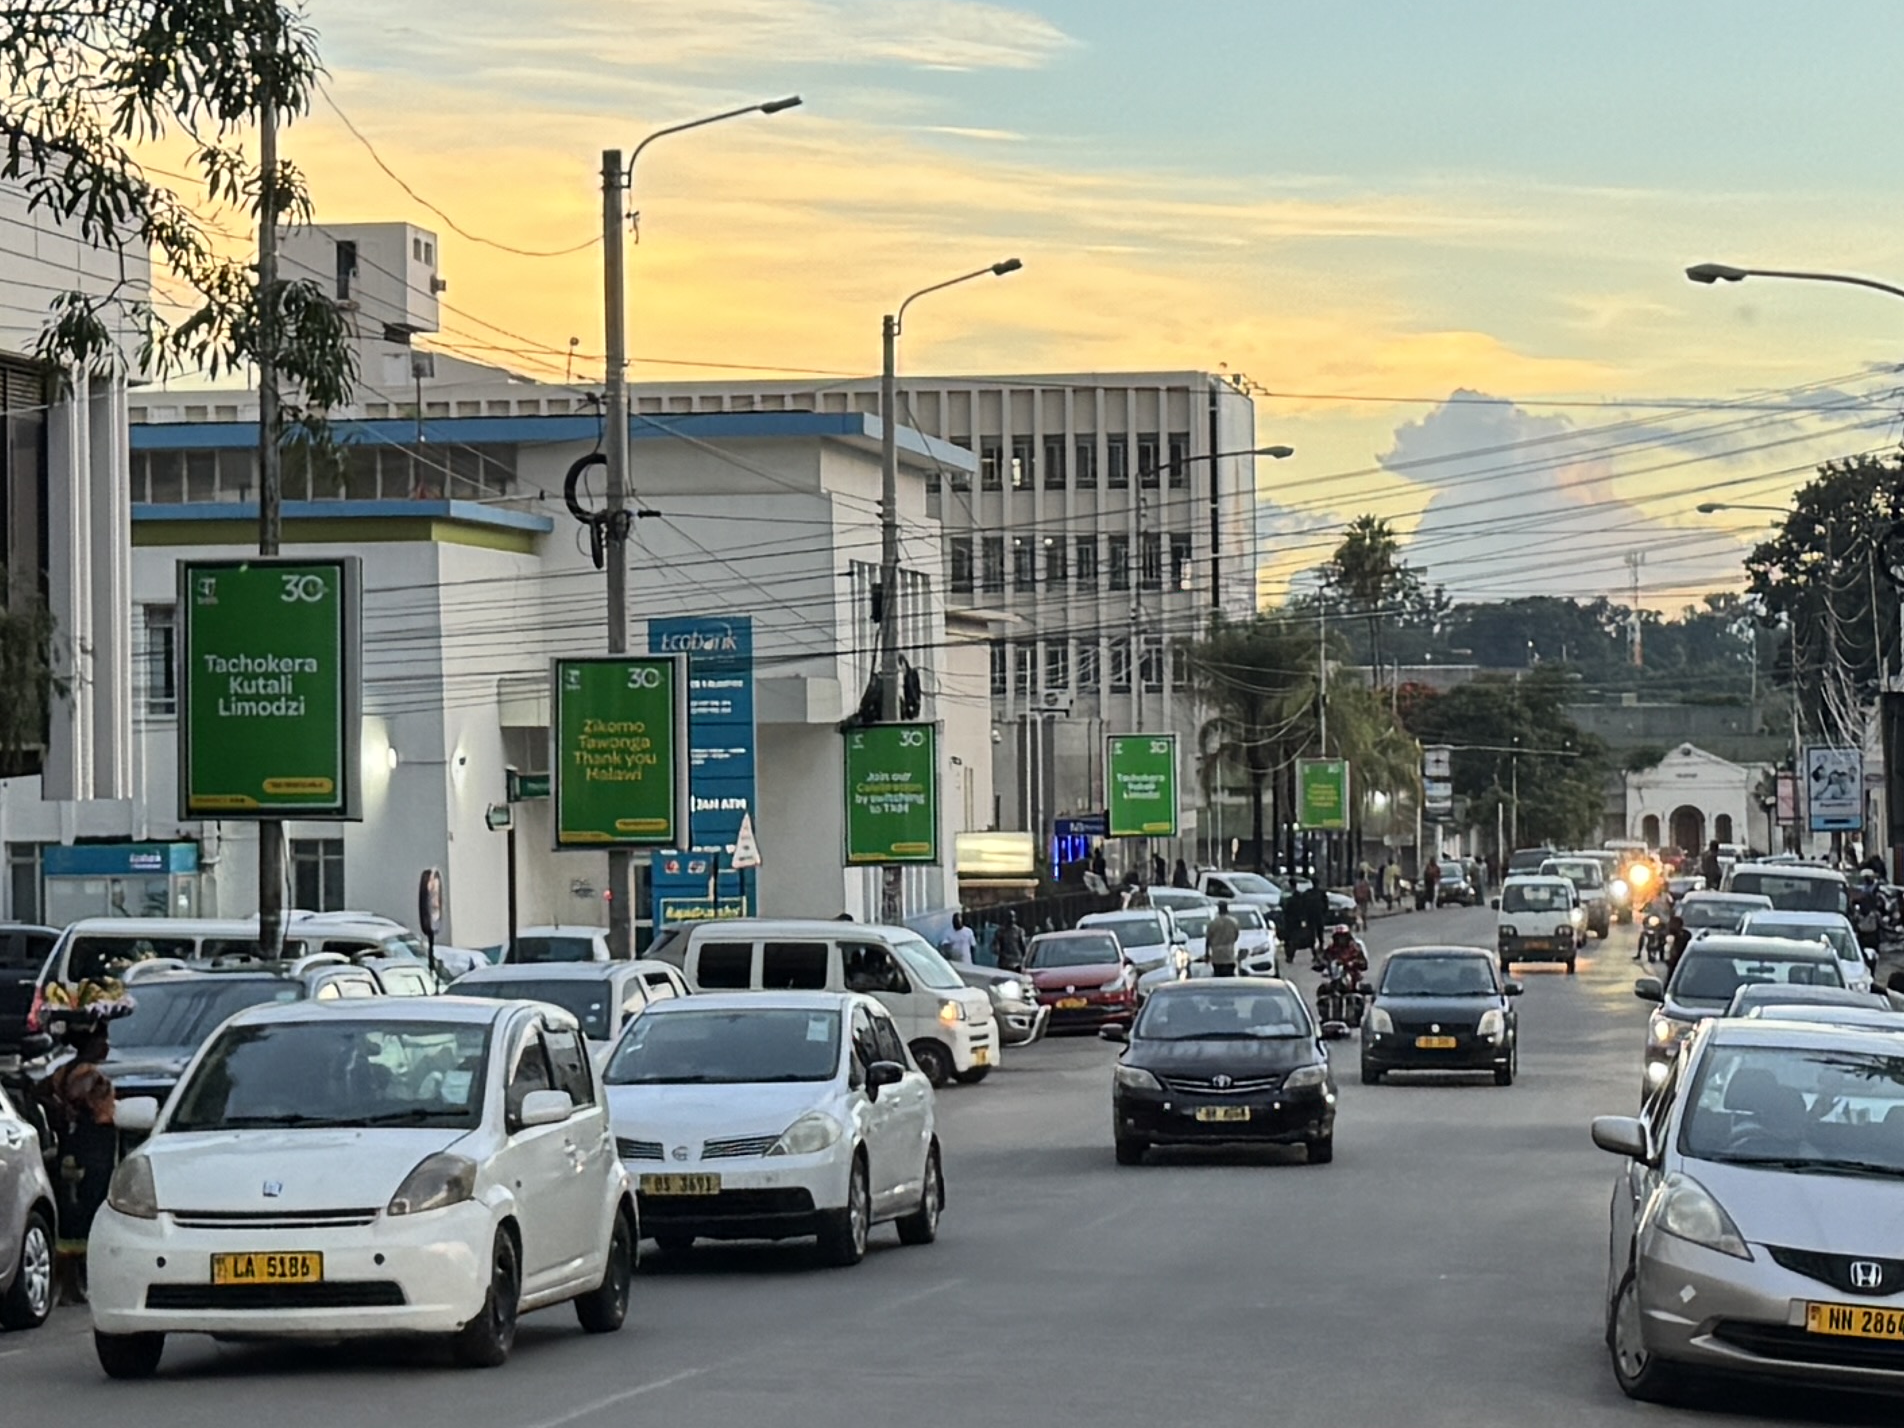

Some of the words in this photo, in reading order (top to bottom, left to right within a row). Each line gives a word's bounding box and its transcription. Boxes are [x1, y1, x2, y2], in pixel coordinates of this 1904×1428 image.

[280, 574, 325, 602] 30
[661, 627, 737, 651] Ecobank
[204, 653, 318, 673] Tachokera
[229, 675, 292, 695] Kutali
[627, 668, 661, 689] 30
[218, 696, 305, 716] Limodzi
[583, 719, 645, 733] Zikomo
[578, 735, 651, 751] Tawonga
[574, 752, 622, 764] Thank
[626, 754, 657, 767] you
[234, 1256, 255, 1278] LA
[267, 1256, 310, 1278] 5186
[1829, 1307, 1853, 1330] NN
